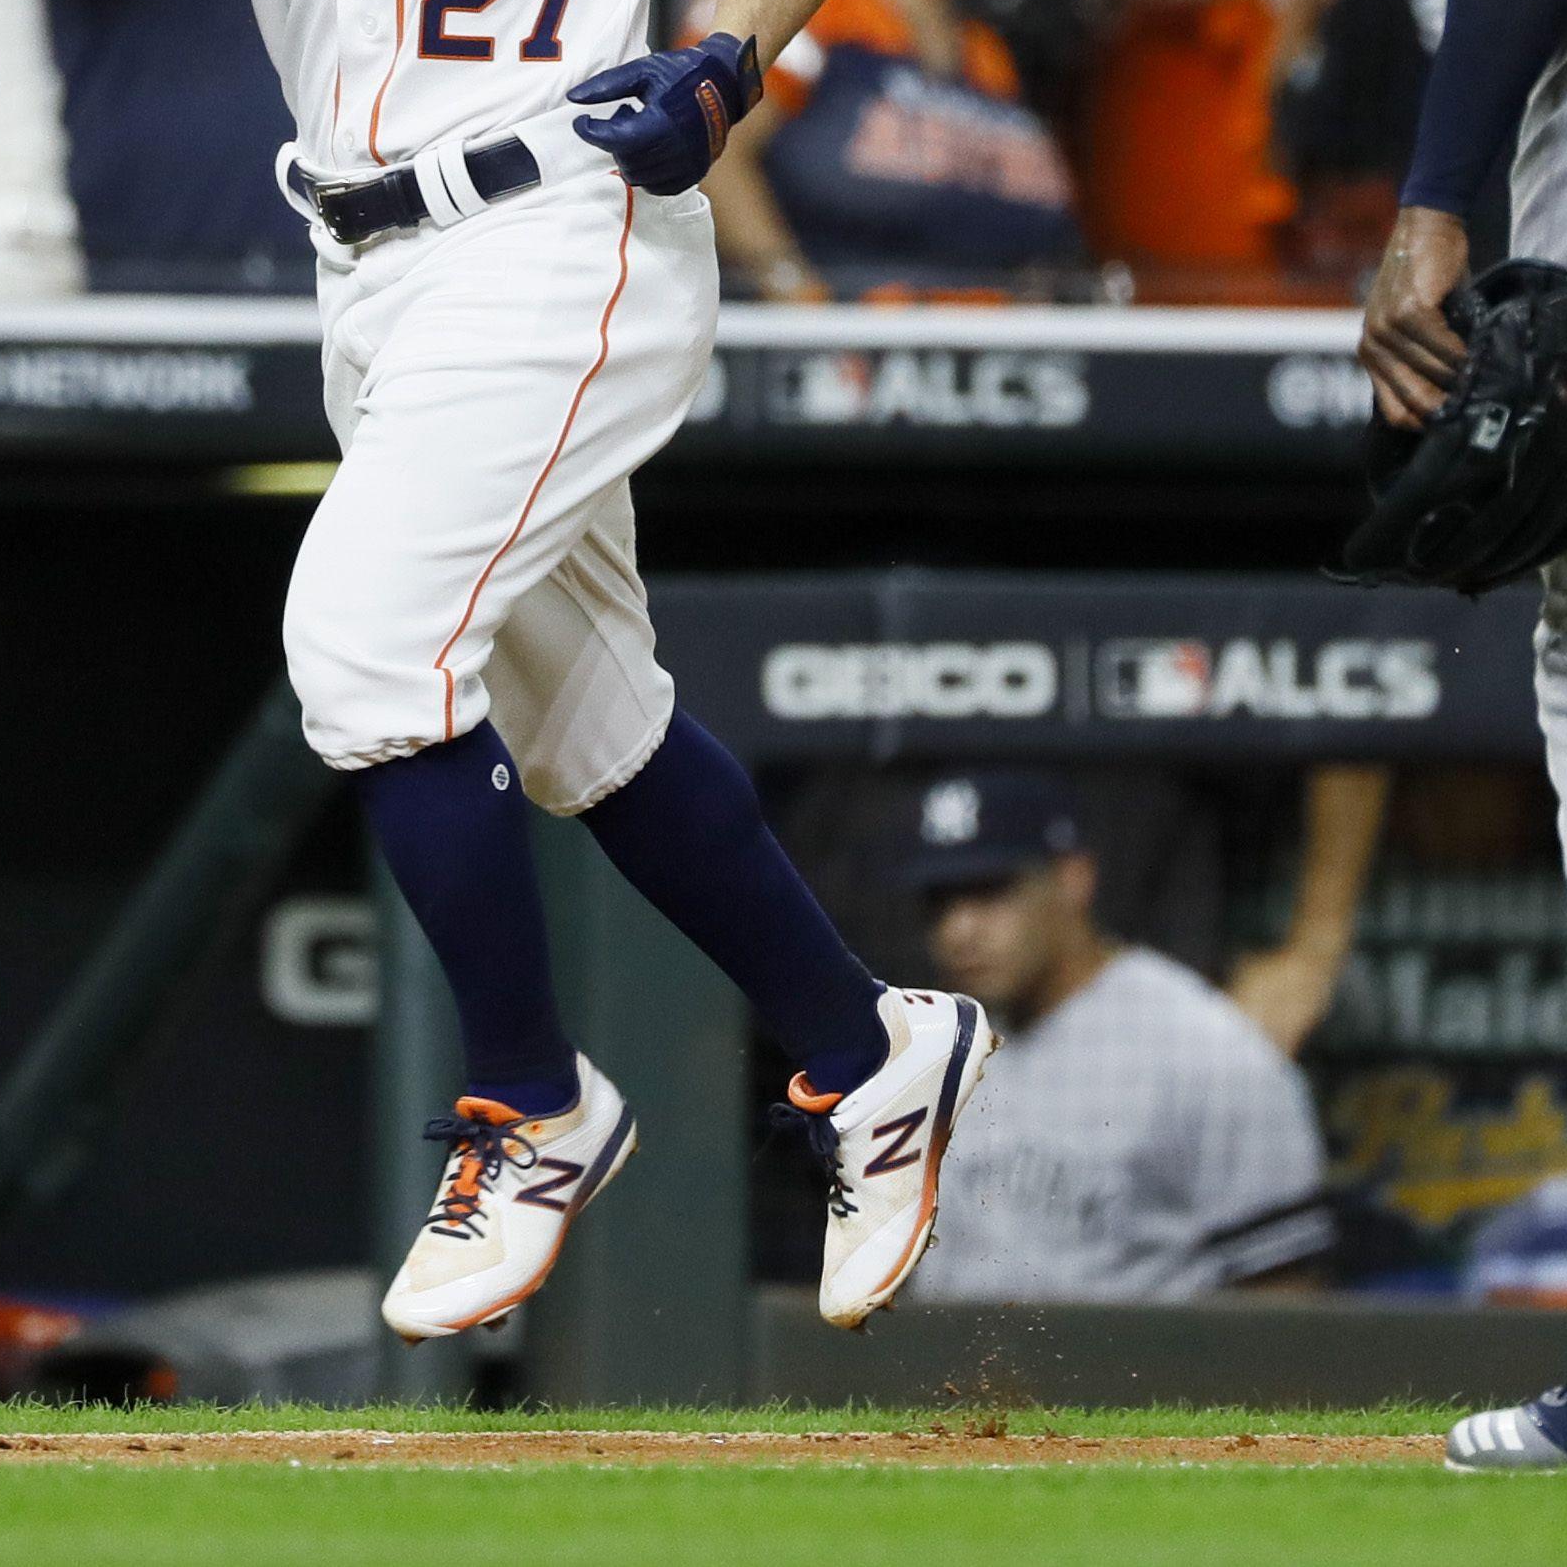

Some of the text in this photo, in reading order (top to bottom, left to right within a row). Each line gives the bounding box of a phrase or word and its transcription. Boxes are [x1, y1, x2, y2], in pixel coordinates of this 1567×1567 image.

[872, 350, 1090, 428] ALCS
[763, 640, 1440, 719] GEICO ALCS
